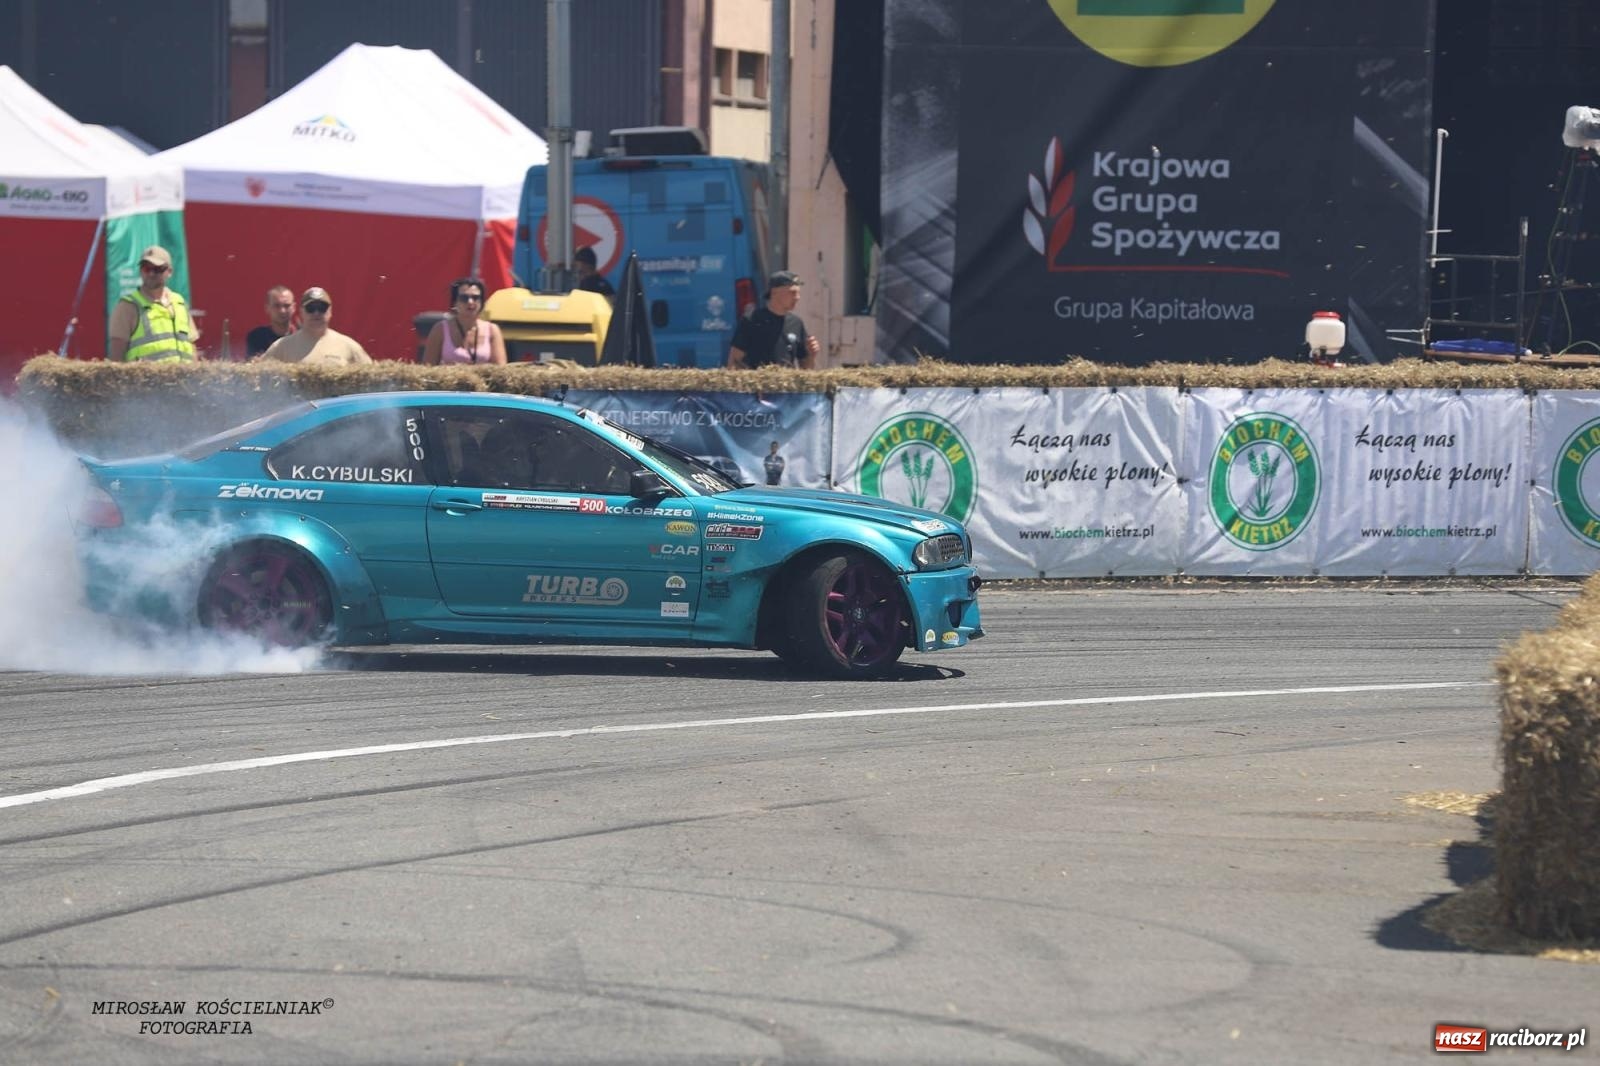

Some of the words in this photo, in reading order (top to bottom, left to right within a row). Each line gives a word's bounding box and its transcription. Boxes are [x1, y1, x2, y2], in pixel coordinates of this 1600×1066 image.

[1092, 151, 1230, 186] Krajowa
[1092, 186, 1198, 220] Grupa
[1091, 222, 1281, 256] Spożywcza
[1054, 296, 1123, 323] Grupa
[1130, 297, 1255, 324] Kapitałowa
[695, 411, 706, 426] Z
[405, 418, 425, 462] 500
[868, 420, 966, 464] BIOCHEM
[1011, 424, 1073, 453] Łączą
[1079, 432, 1112, 447] nas
[1219, 420, 1310, 464] BIOCHEM
[1355, 424, 1417, 453] Łączą
[1423, 432, 1456, 447] nas
[292, 464, 413, 483] K.CYBULSKI
[1025, 459, 1098, 489] wysokie
[1105, 461, 1169, 489] plony!
[1369, 459, 1441, 488] wysokie
[1448, 462, 1512, 489] plony!
[582, 500, 603, 512] 500
[1019, 524, 1154, 540] www.biochemkietrz.pl
[1230, 517, 1294, 544] KIETRZ
[1361, 525, 1497, 539] www.biochemkietrz.pl
